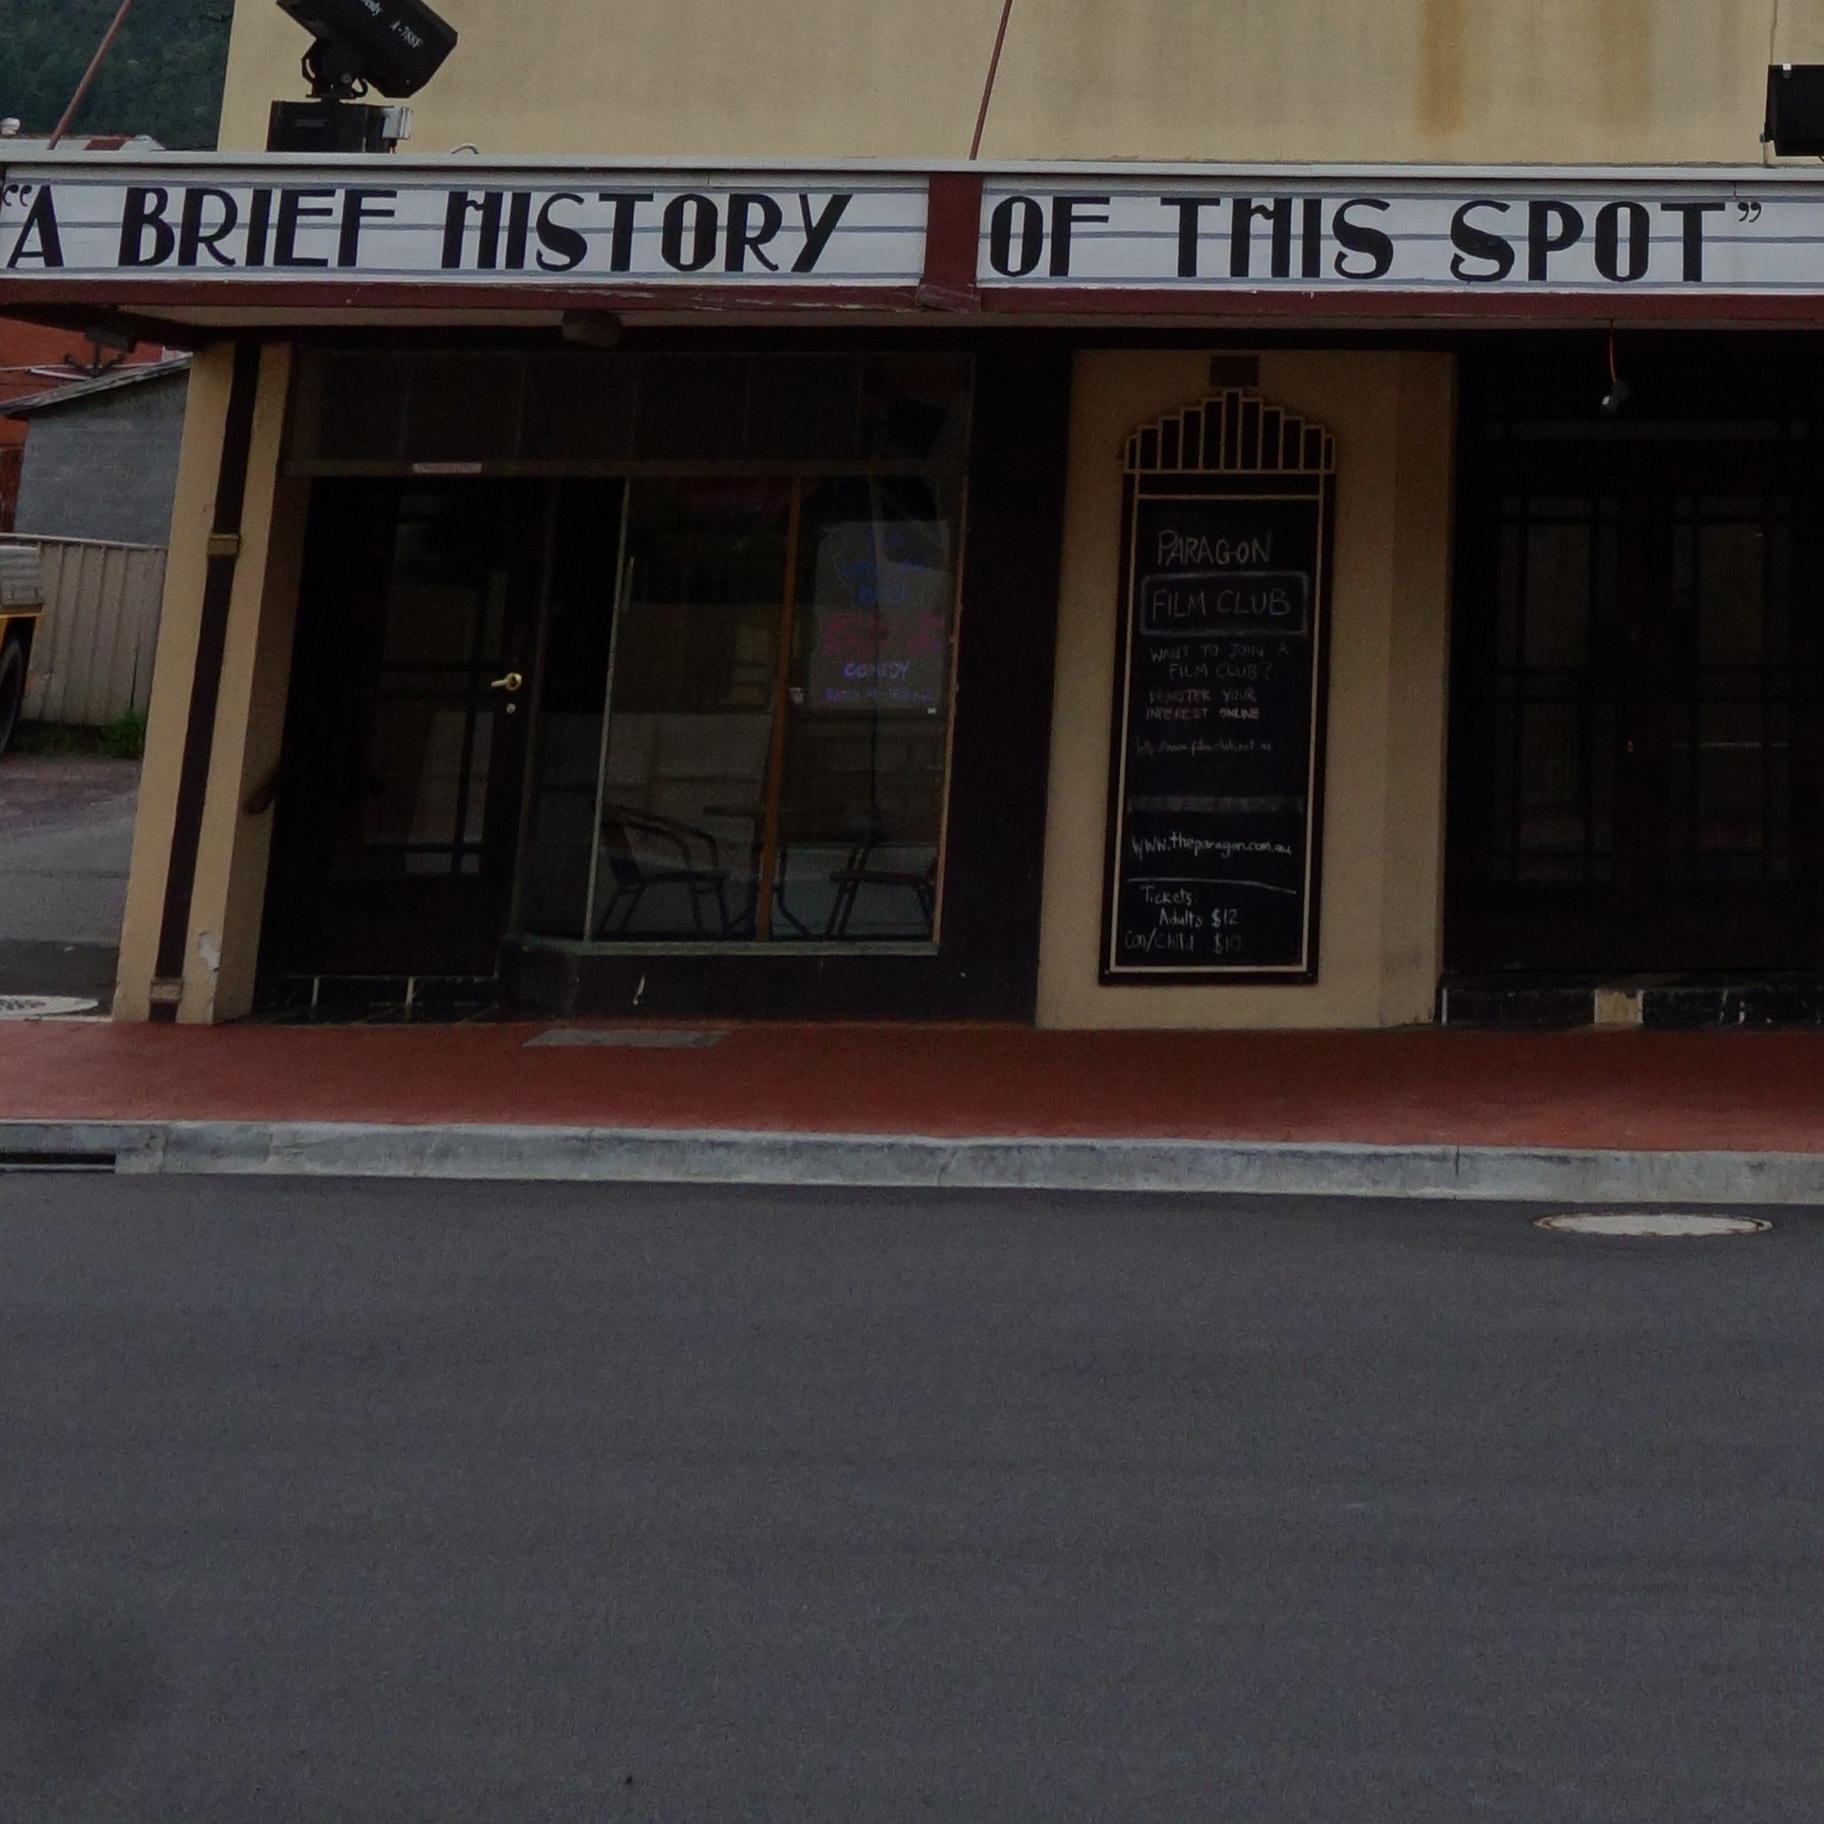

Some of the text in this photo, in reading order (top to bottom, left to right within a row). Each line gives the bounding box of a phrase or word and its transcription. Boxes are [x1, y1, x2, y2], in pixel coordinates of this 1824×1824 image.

[118, 186, 397, 268] BRIEF
[440, 190, 854, 273] HISTORY
[989, 195, 1111, 278] OF
[1160, 197, 1395, 280] THIS
[1157, 529, 1272, 567] PARAGON
[1152, 588, 1290, 622] FILM CLUB
[1149, 642, 1289, 663] WANT TO JOIN A
[1168, 662, 1209, 681] FILM
[1221, 687, 1258, 703] YOUR
[1211, 908, 1240, 929] $12
[1214, 932, 1243, 955] $10
